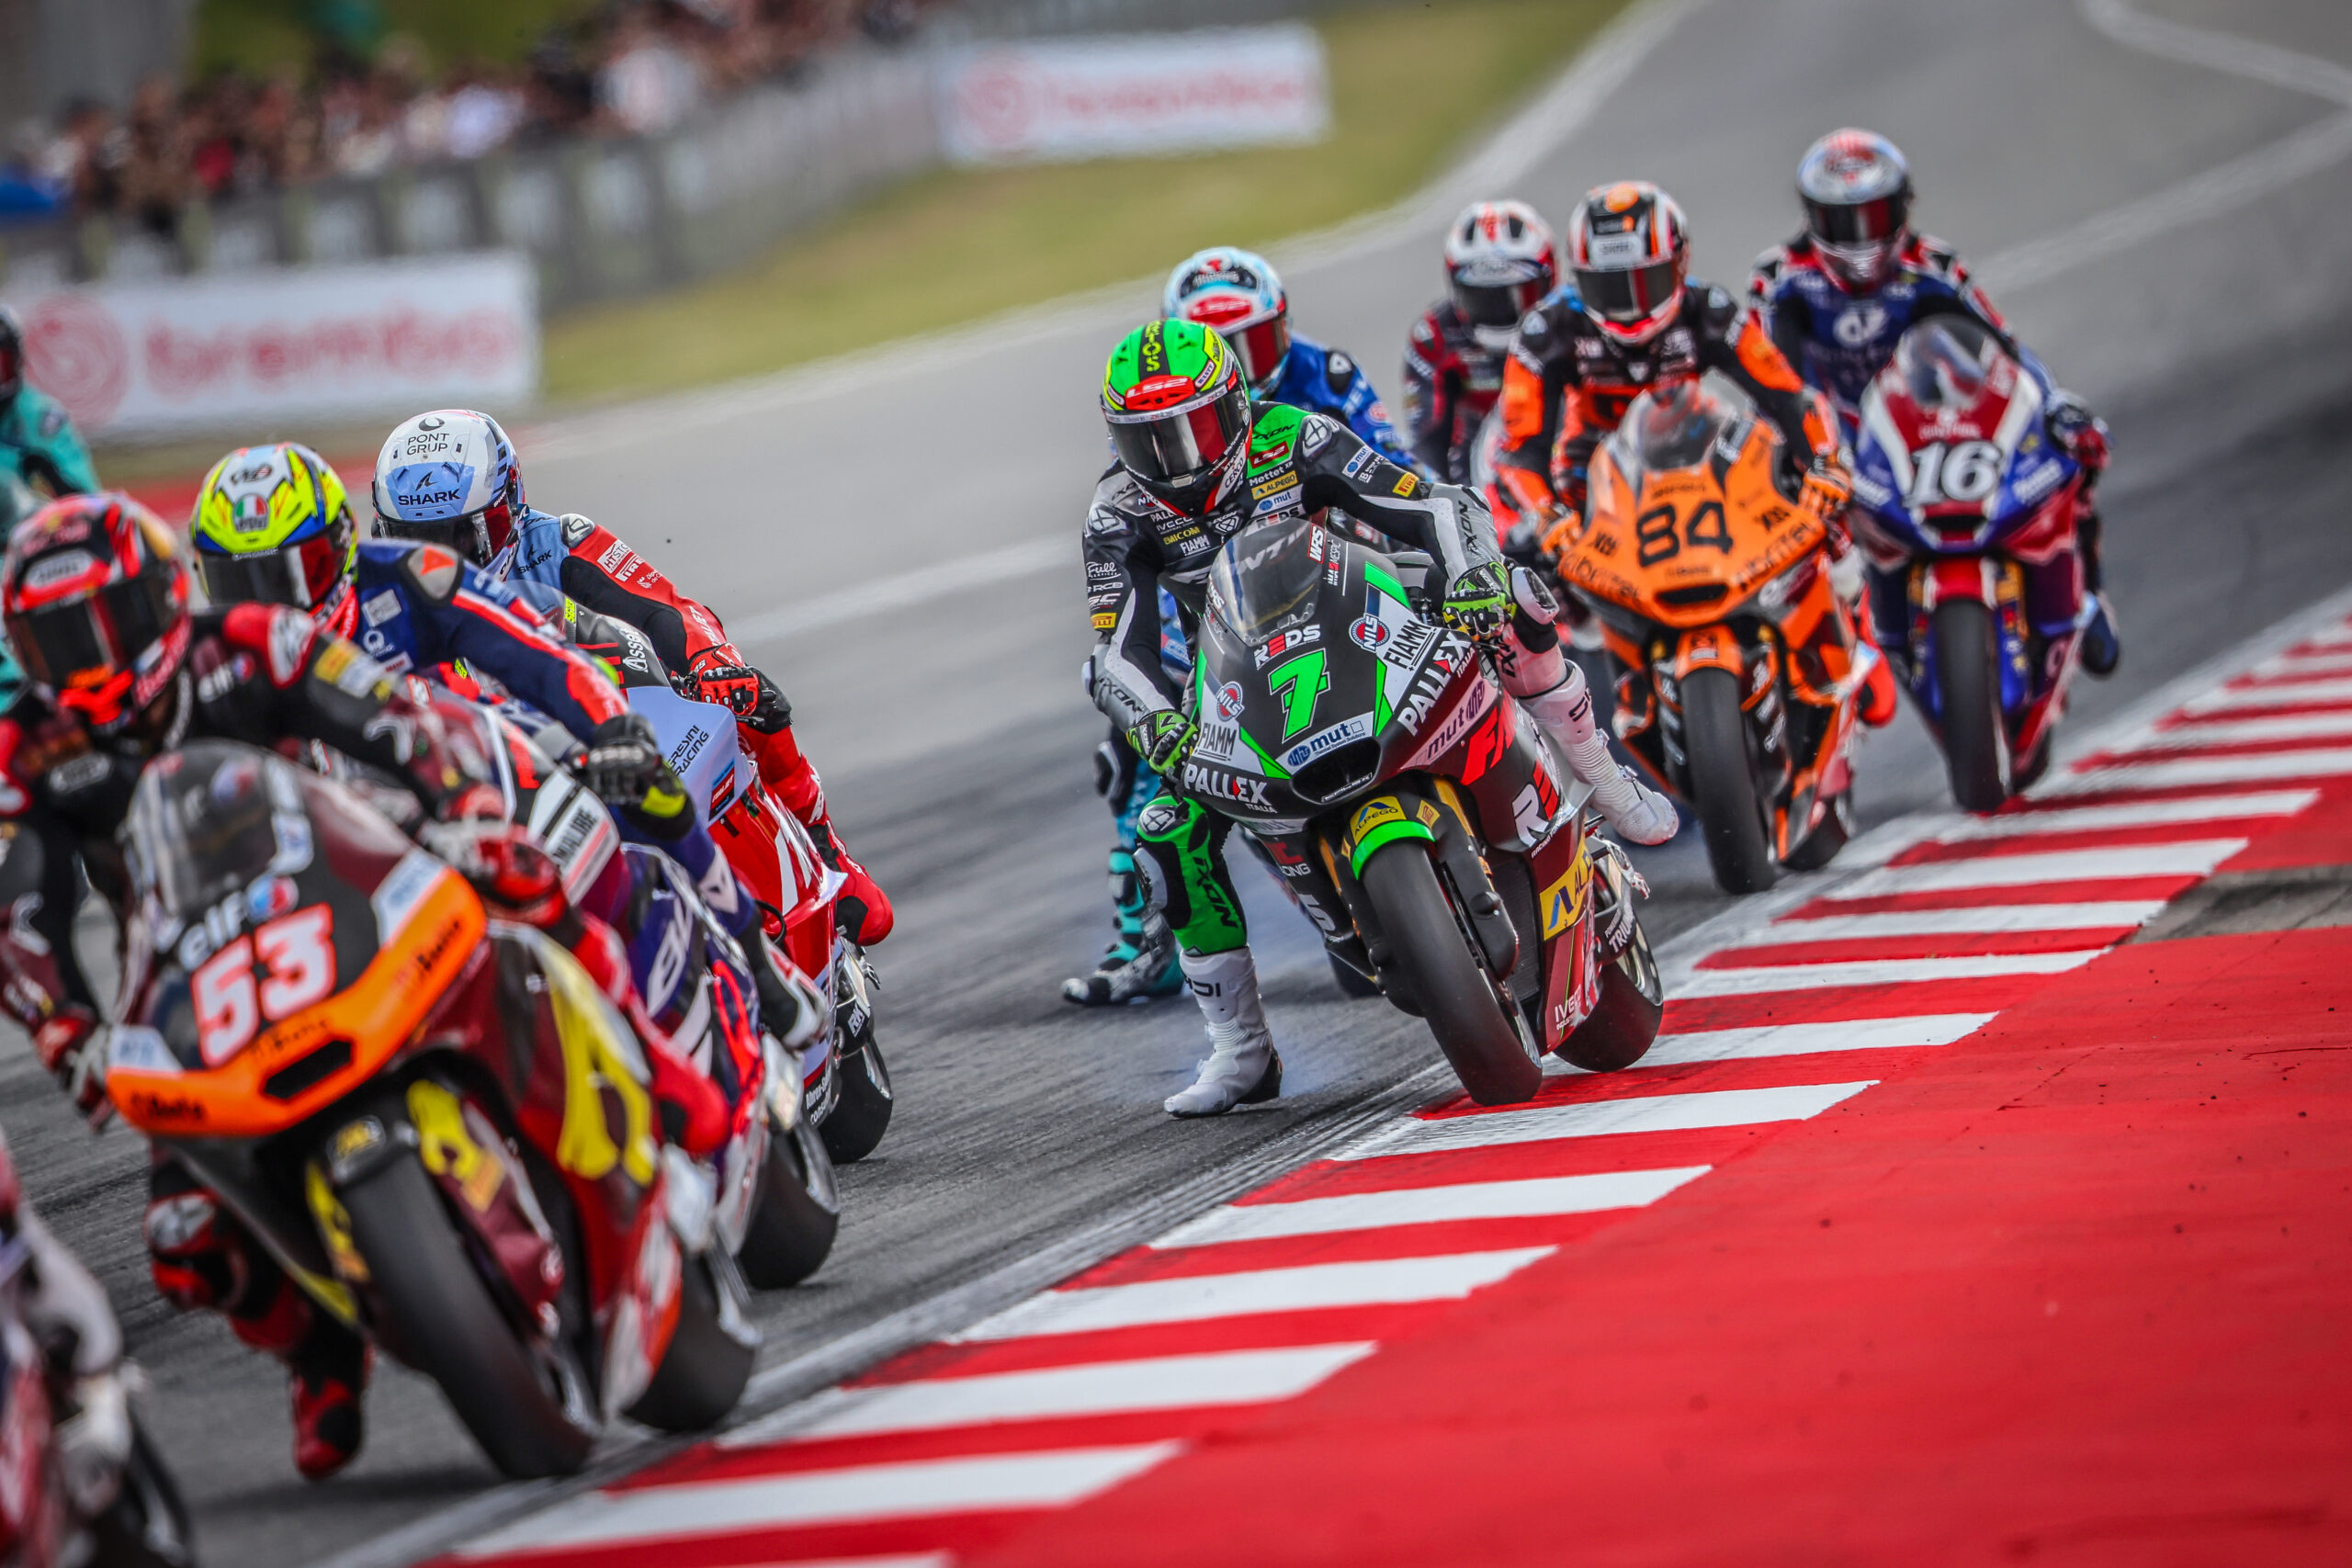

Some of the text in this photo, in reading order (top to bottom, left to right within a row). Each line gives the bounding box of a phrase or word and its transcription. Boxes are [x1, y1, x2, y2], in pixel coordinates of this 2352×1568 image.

[1127, 377, 1189, 398] LS2
[406, 443, 448, 456] GRUP
[407, 433, 450, 446] PONT
[1253, 445, 1286, 465] LS2
[1250, 465, 1284, 487] Mettet
[1266, 474, 1295, 492] ALPEGO
[1903, 439, 2003, 508] 16
[399, 489, 461, 506] SHARK
[1273, 491, 1292, 505] mut
[1150, 510, 1177, 525] PALL
[1180, 535, 1210, 554] FIAMM
[1635, 501, 1734, 568] 84
[518, 549, 552, 574] SHARK
[1362, 614, 1379, 650] NILS
[1383, 619, 1434, 669] FIAMM
[1253, 624, 1321, 671] REDS
[1268, 647, 1331, 745] 7
[1397, 630, 1473, 737] PALLEX
[1216, 688, 1242, 716] NILS
[1198, 722, 1238, 756] FIAMM
[1309, 723, 1351, 751] mut
[1427, 706, 1464, 760] mut
[674, 731, 709, 775] RACING
[1183, 763, 1272, 807] PALLEX
[1245, 802, 1278, 815] ITALIA
[1354, 806, 1399, 836] ALPEGO
[1575, 851, 1593, 905] ALP
[191, 902, 337, 1068] 53
